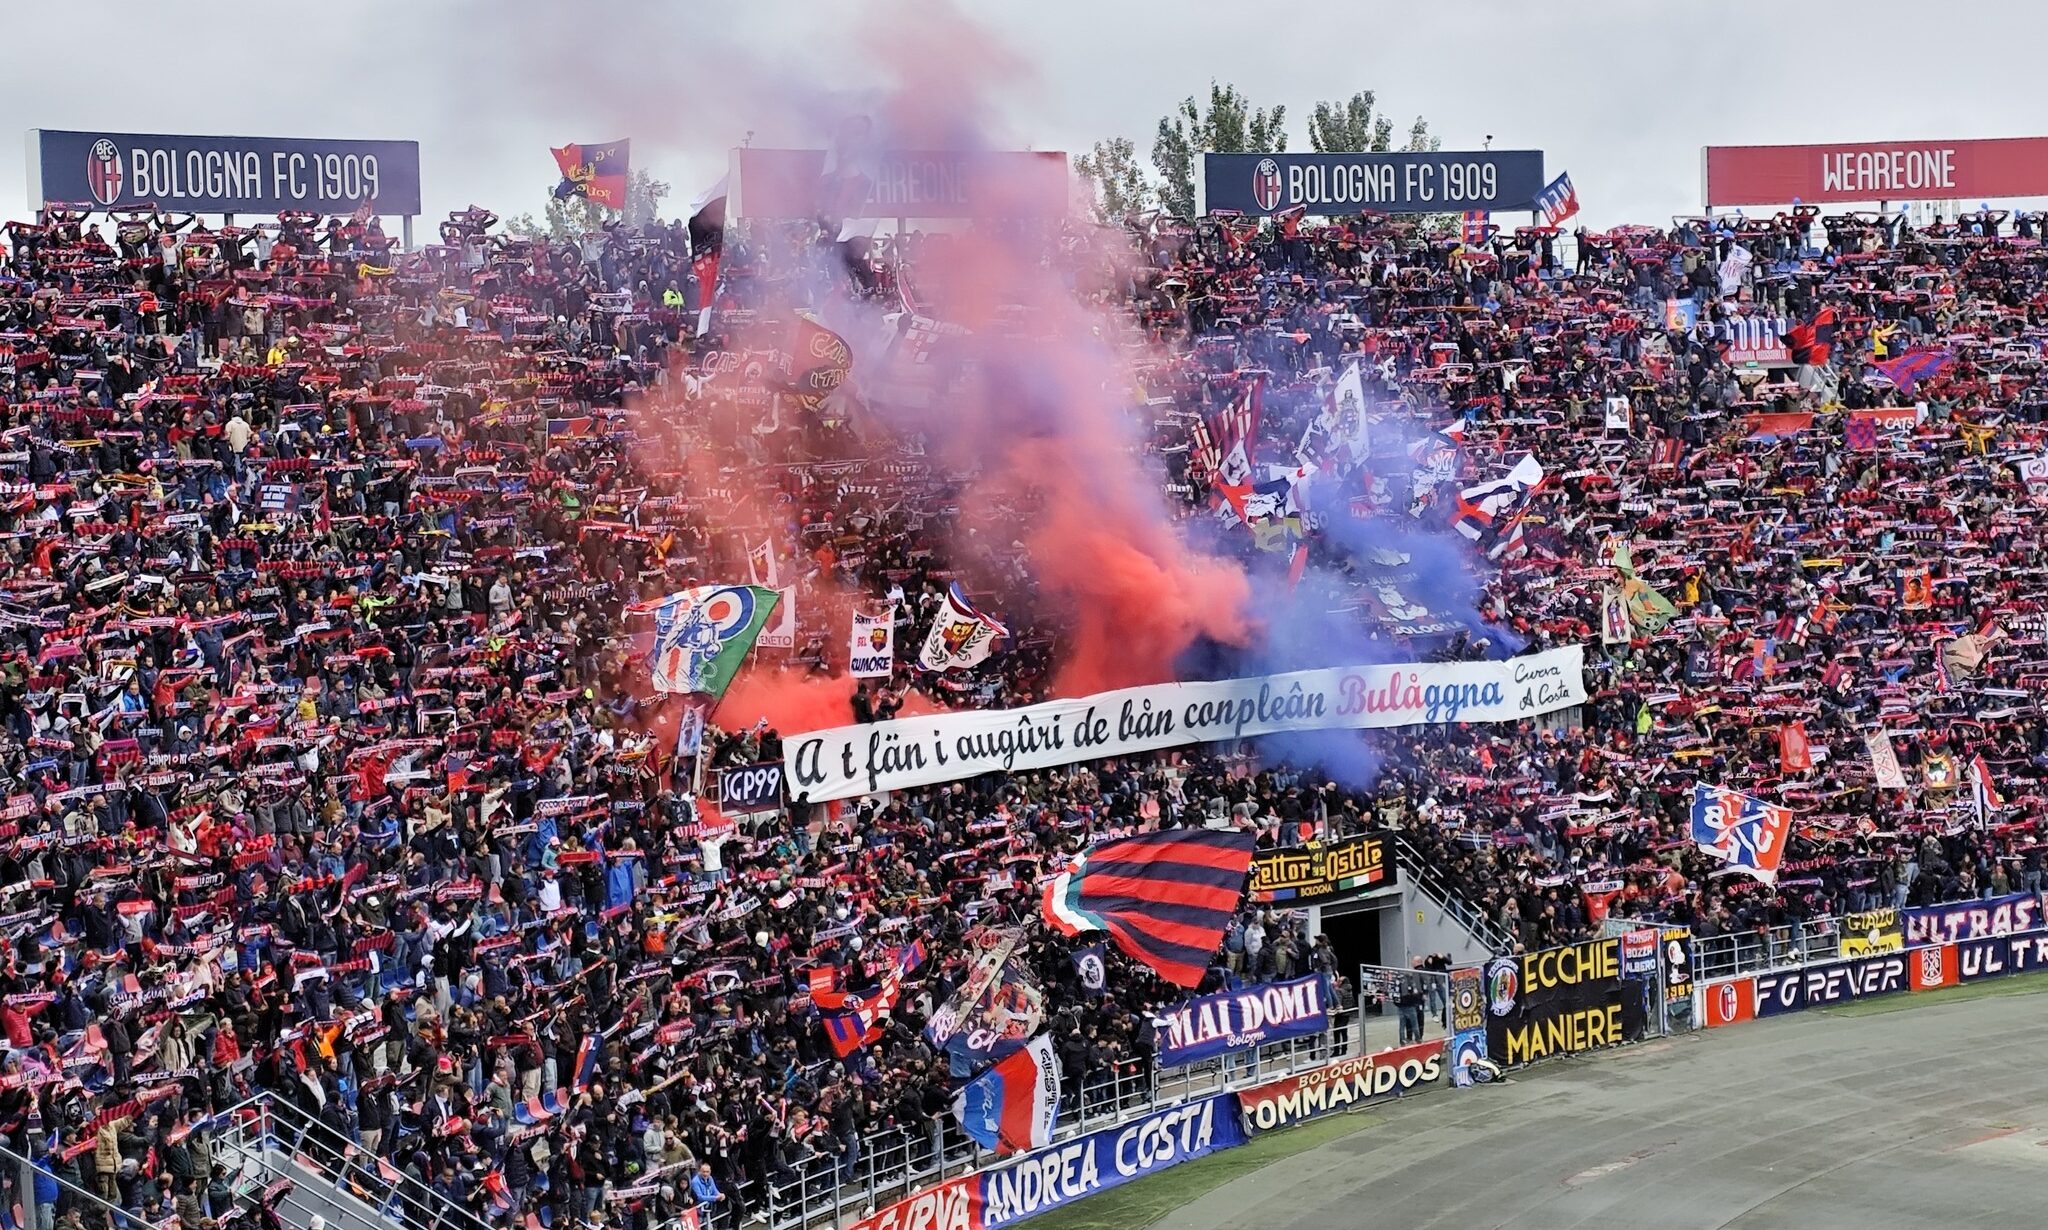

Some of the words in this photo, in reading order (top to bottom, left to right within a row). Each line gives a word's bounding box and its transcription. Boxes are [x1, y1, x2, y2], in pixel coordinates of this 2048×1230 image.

[131, 148, 262, 199] BOLOGNA
[272, 151, 307, 200] FC
[312, 152, 380, 201] 1909
[1288, 164, 1396, 204] BOLOGNA
[1405, 163, 1434, 202] FC
[1439, 162, 1497, 201] 1909
[1822, 148, 1956, 193] WEAREONE
[1885, 415, 1915, 431] CATS
[851, 656, 891, 672] RUMORE
[1514, 663, 1562, 685] Curva
[795, 738, 828, 787] A
[841, 741, 857, 780] t
[865, 730, 928, 792] fän
[933, 729, 949, 767] i
[956, 714, 1065, 770] augûri
[1073, 706, 1110, 748] de
[1118, 697, 1175, 742] bån
[1183, 681, 1327, 738] conpleân
[1336, 671, 1504, 722] Bulåggna
[1326, 840, 1383, 882] Ostile
[1300, 883, 1334, 898] BOLOGNA
[1907, 897, 2036, 944] ULTRAS
[1523, 938, 1619, 994] ECCHIE
[1756, 959, 1904, 1018] FOREVER
[1165, 999, 1233, 1050] MAI
[1237, 979, 1322, 1032] DOMI
[1506, 1004, 1623, 1066] MANIERE
[1299, 1056, 1375, 1088] BOLOGNA
[984, 1138, 1102, 1228] ANDREA
[1115, 1098, 1214, 1178] COSTA
